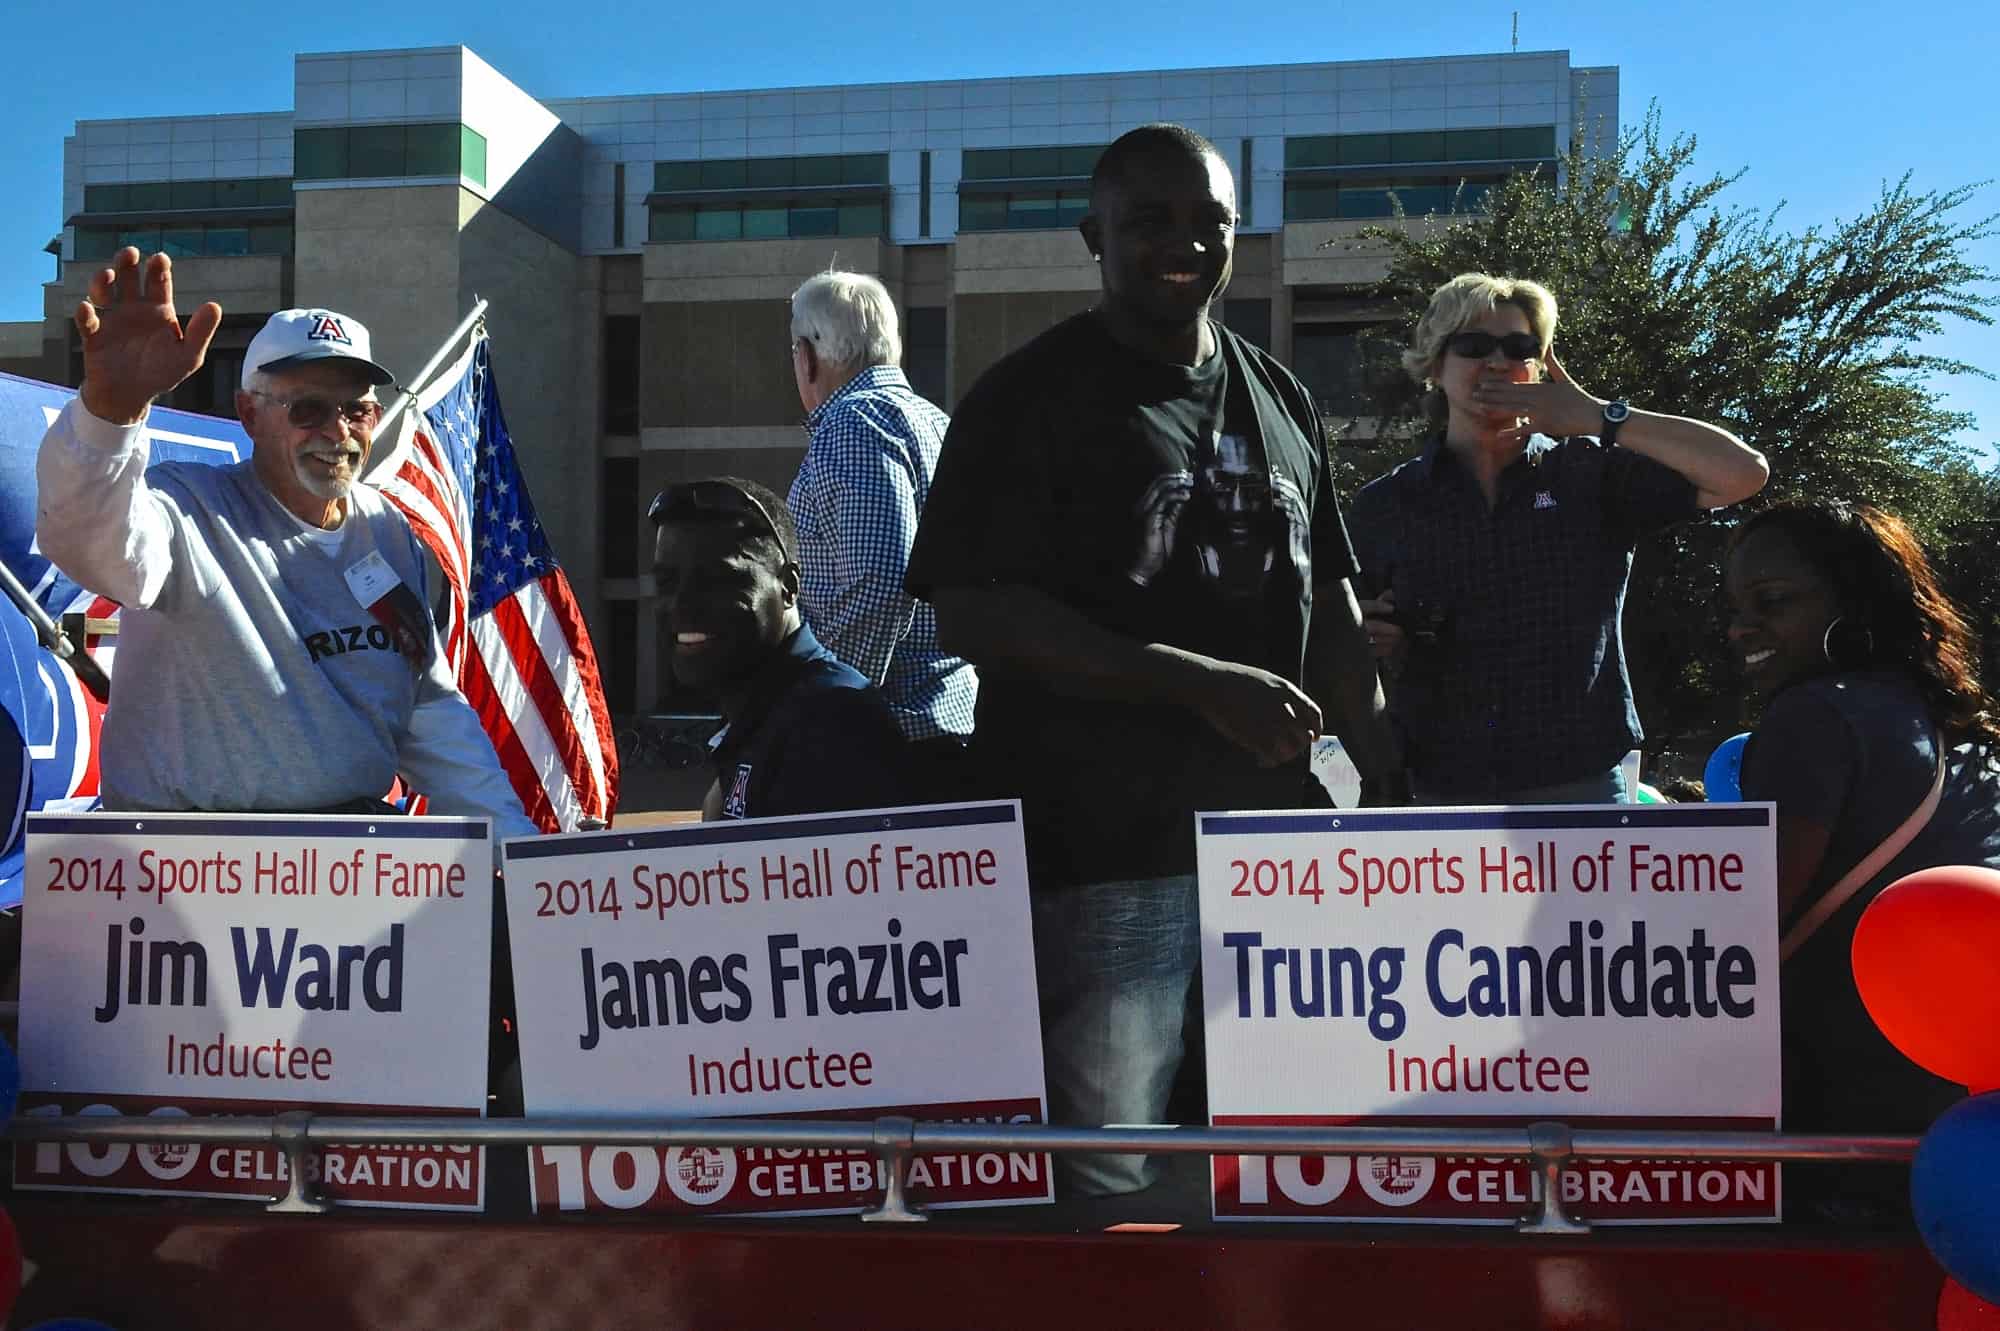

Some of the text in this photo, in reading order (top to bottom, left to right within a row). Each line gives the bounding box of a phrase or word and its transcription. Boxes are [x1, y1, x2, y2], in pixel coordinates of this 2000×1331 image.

[304, 624, 402, 664] RIZO
[48, 849, 465, 904] 2014 Sports Hall of Fame
[535, 844, 996, 920] 2014 Sports Hall of Fame
[1231, 840, 1743, 907] 2014 Sports Hall of Fame
[95, 917, 405, 1023] Jim Ward
[580, 918, 968, 1050] James Frazier
[1223, 920, 1756, 1041] Trung Candidate
[168, 1032, 332, 1080] Inductee
[689, 1047, 872, 1096] Inductee
[1388, 1045, 1589, 1093] Inductee
